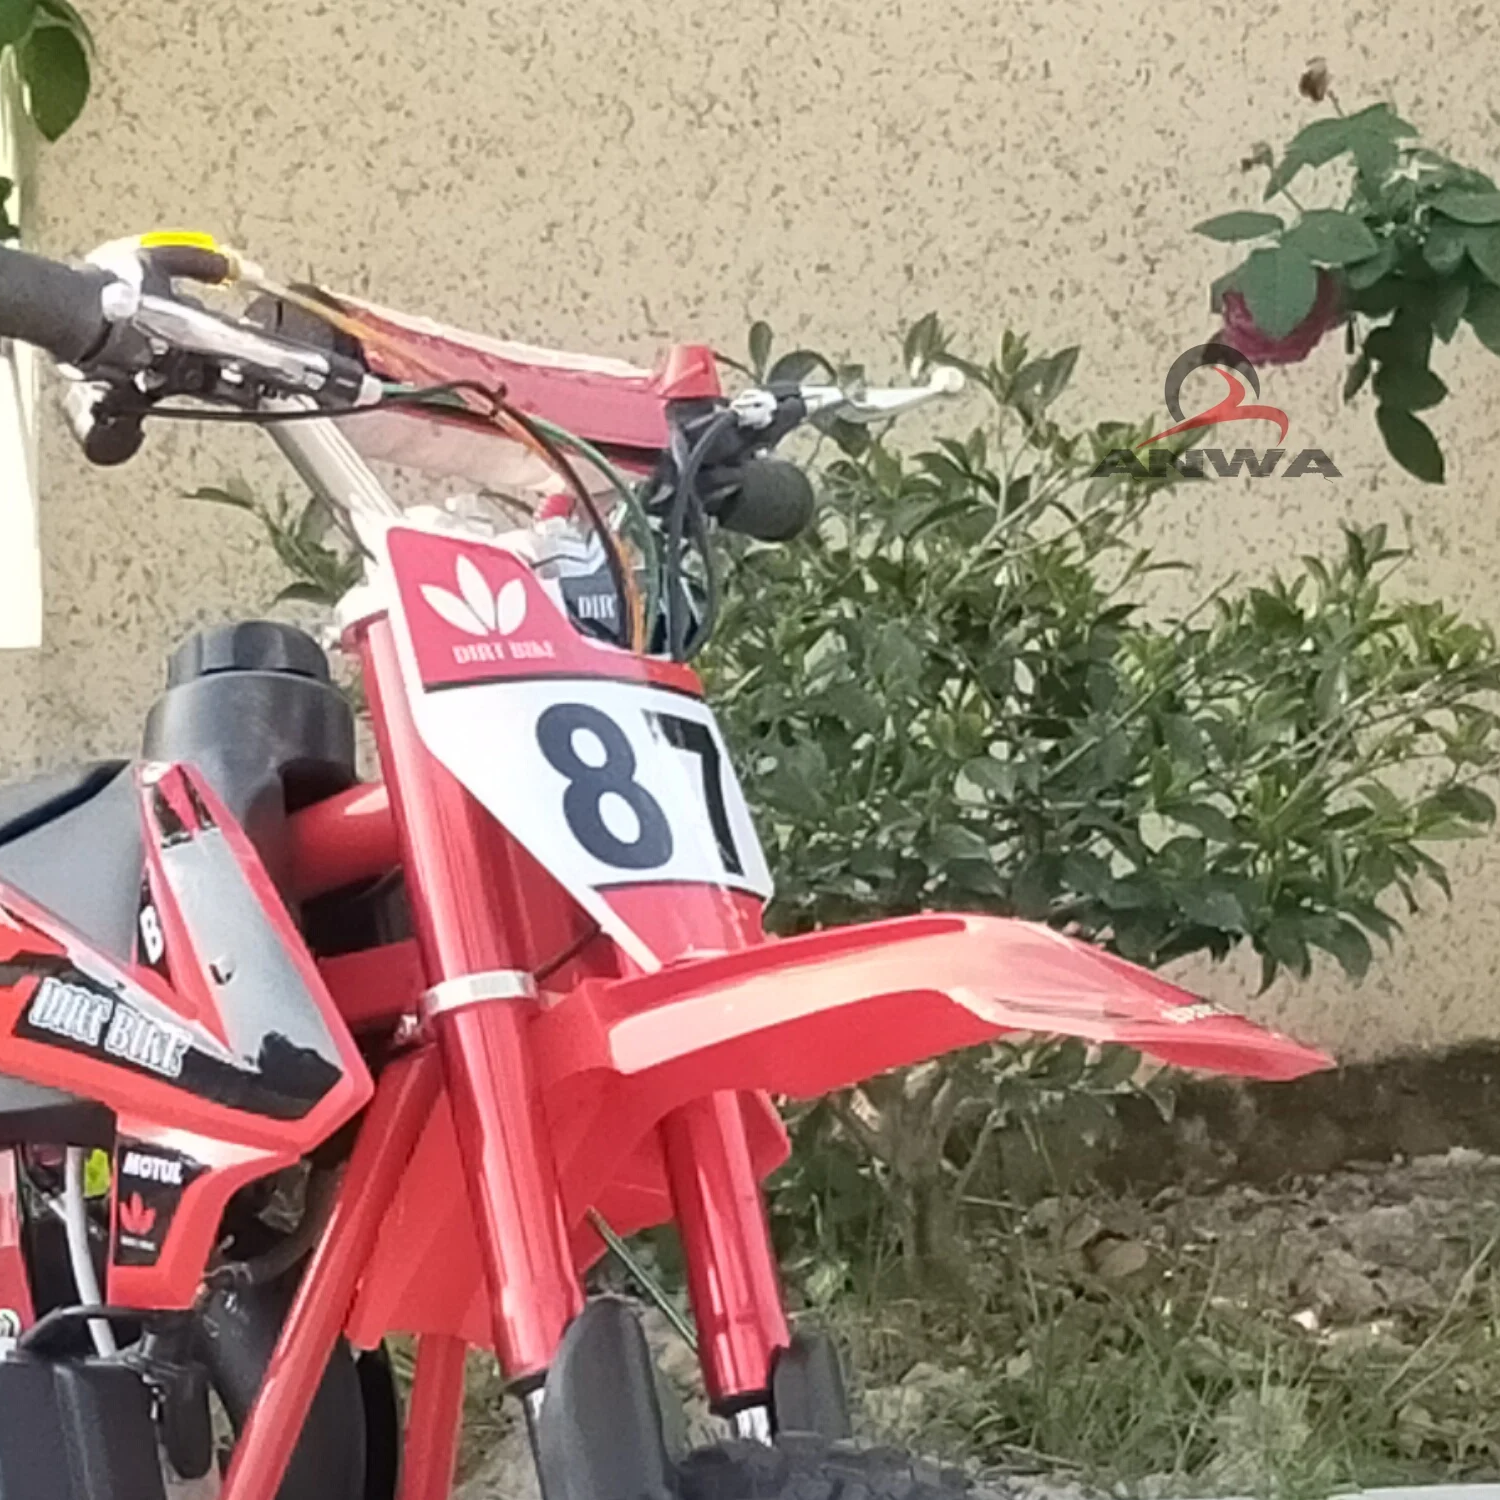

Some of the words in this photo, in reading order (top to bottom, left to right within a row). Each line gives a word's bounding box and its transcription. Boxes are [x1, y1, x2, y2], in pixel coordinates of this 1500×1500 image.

[578, 591, 618, 620] DIR
[535, 702, 745, 877] 87
[122, 1151, 183, 1185] MOTUL
